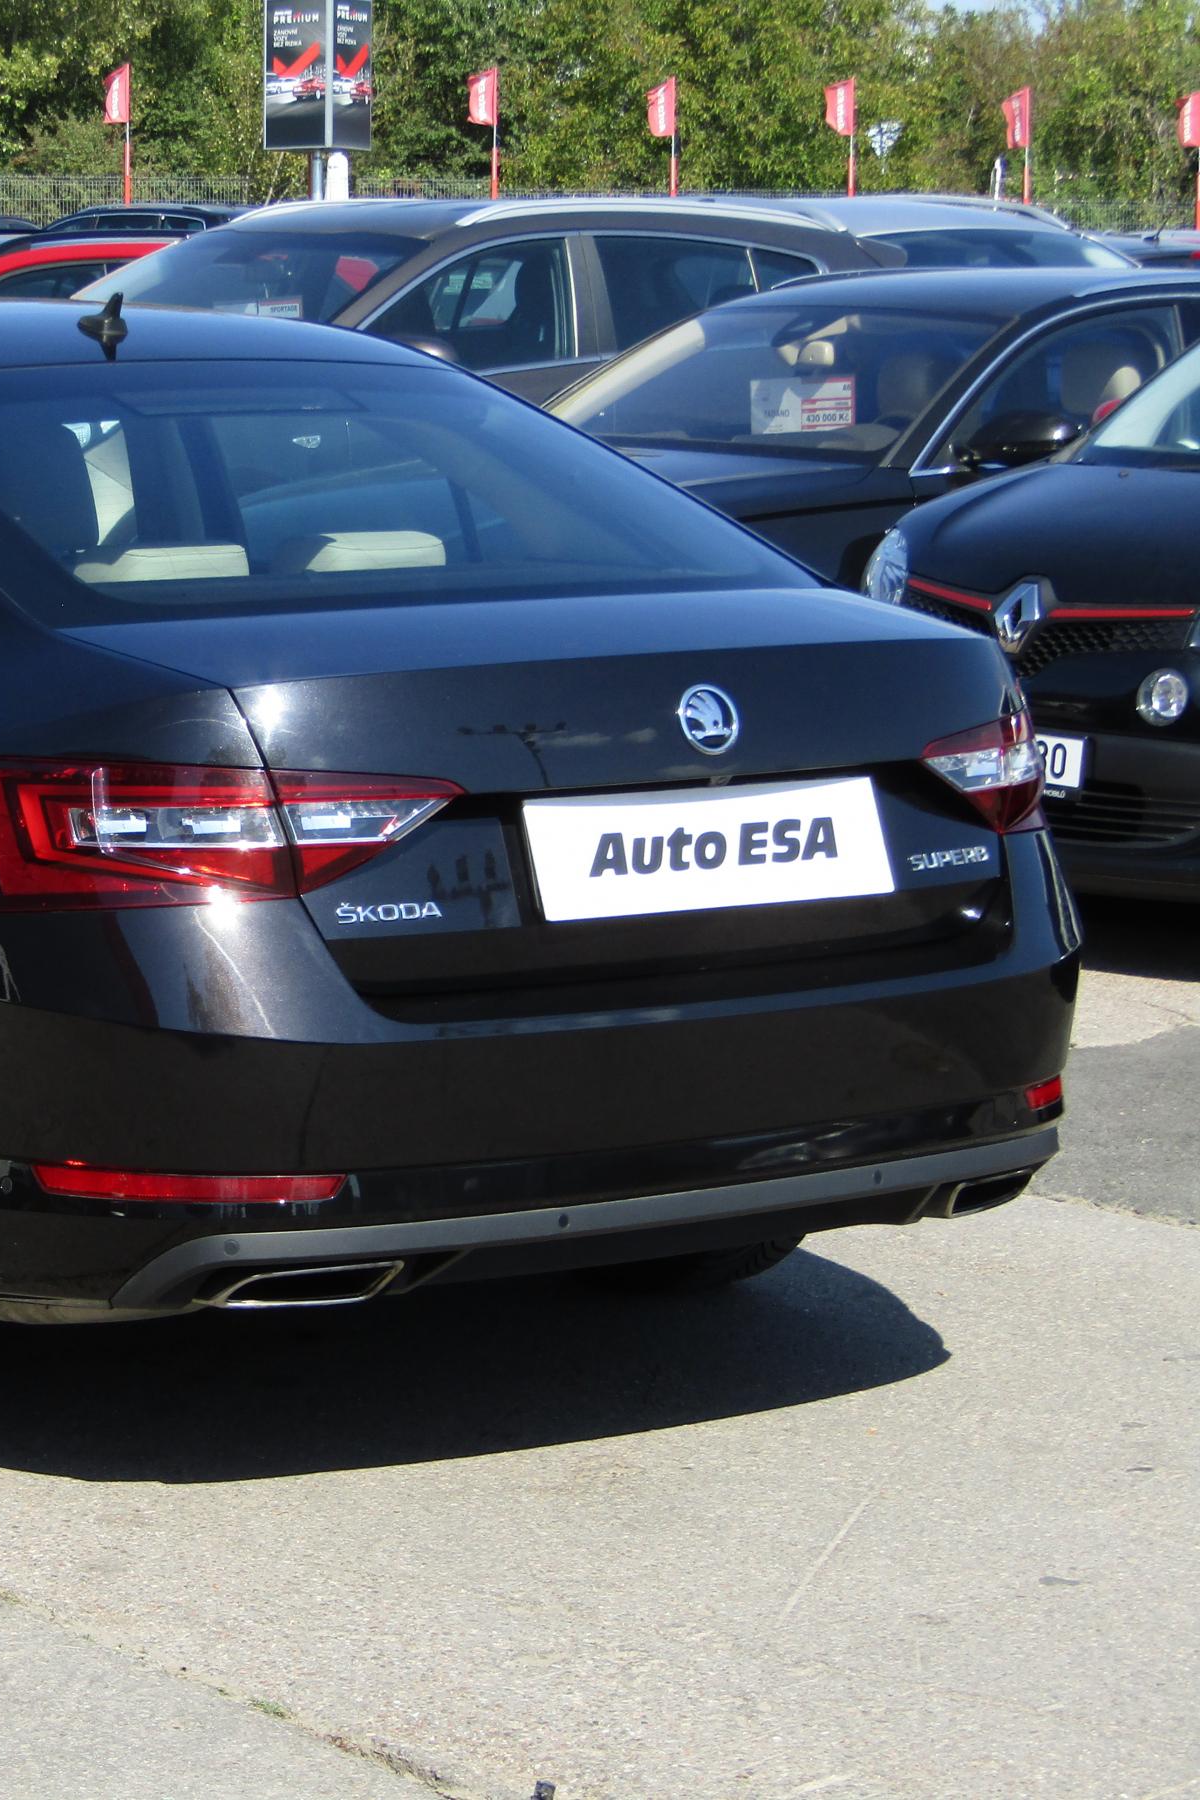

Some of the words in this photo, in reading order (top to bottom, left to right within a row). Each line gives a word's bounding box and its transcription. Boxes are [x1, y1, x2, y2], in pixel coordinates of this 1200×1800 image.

[273, 11, 319, 24] PREMIUM
[270, 304, 298, 313] SPORTAGE
[822, 412, 837, 422] 000
[589, 827, 727, 877] Auto
[738, 817, 838, 866] ESA
[907, 846, 989, 871] SUPERB
[336, 902, 442, 924] ŠKODA
